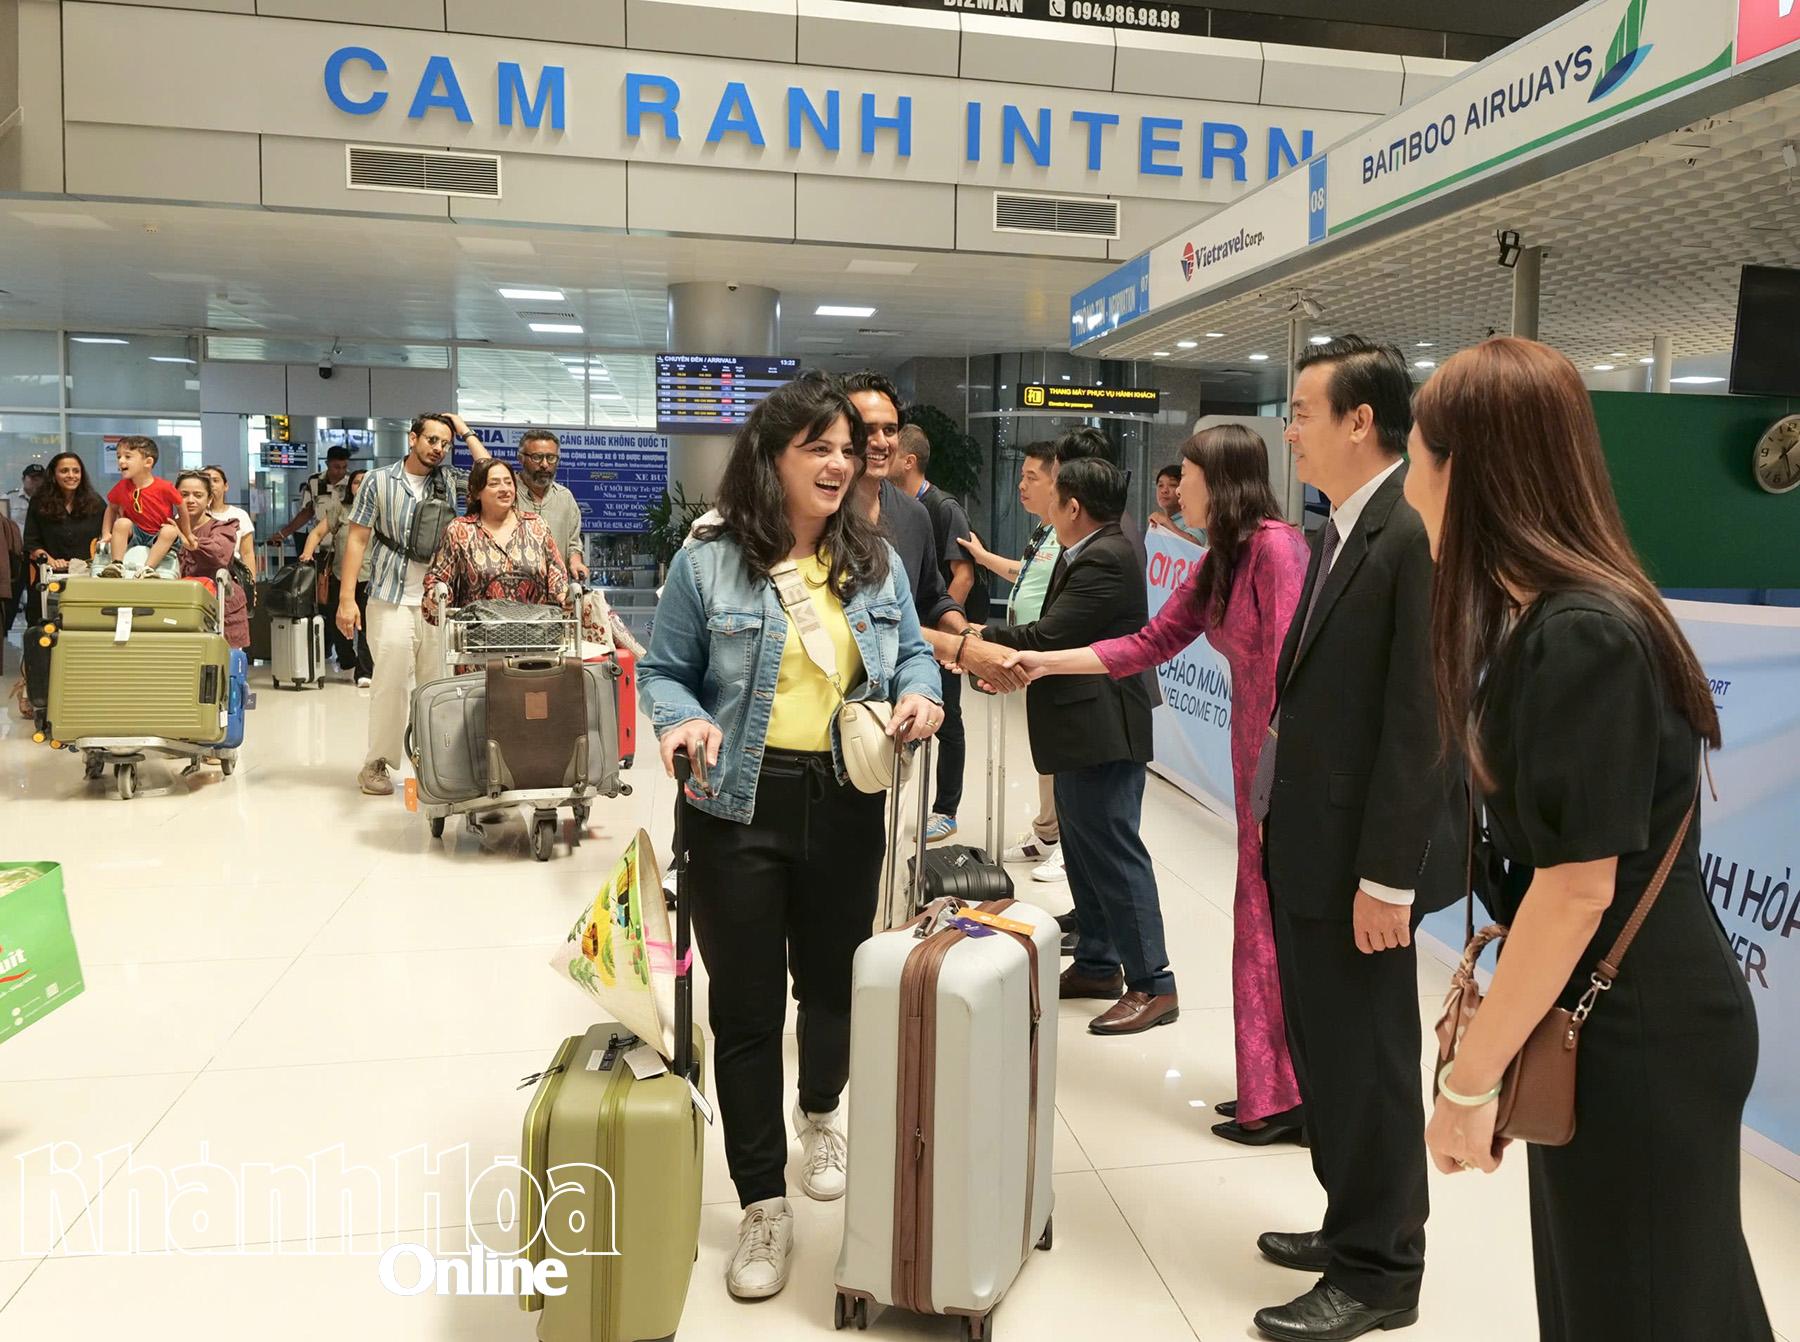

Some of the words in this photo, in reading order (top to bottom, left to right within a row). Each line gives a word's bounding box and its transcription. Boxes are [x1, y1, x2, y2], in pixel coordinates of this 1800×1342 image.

[1072, 1, 1181, 29] 094.986.98.98
[324, 46, 566, 131] CAM
[625, 73, 912, 156] RANH
[1362, 114, 1456, 184] BAMBOO
[1464, 44, 1593, 135] AIRWAYS
[1310, 187, 1325, 213] 08
[1194, 228, 1245, 270] Vietravel
[635, 473, 649, 481] XE
[1213, 704, 1228, 728] TO
